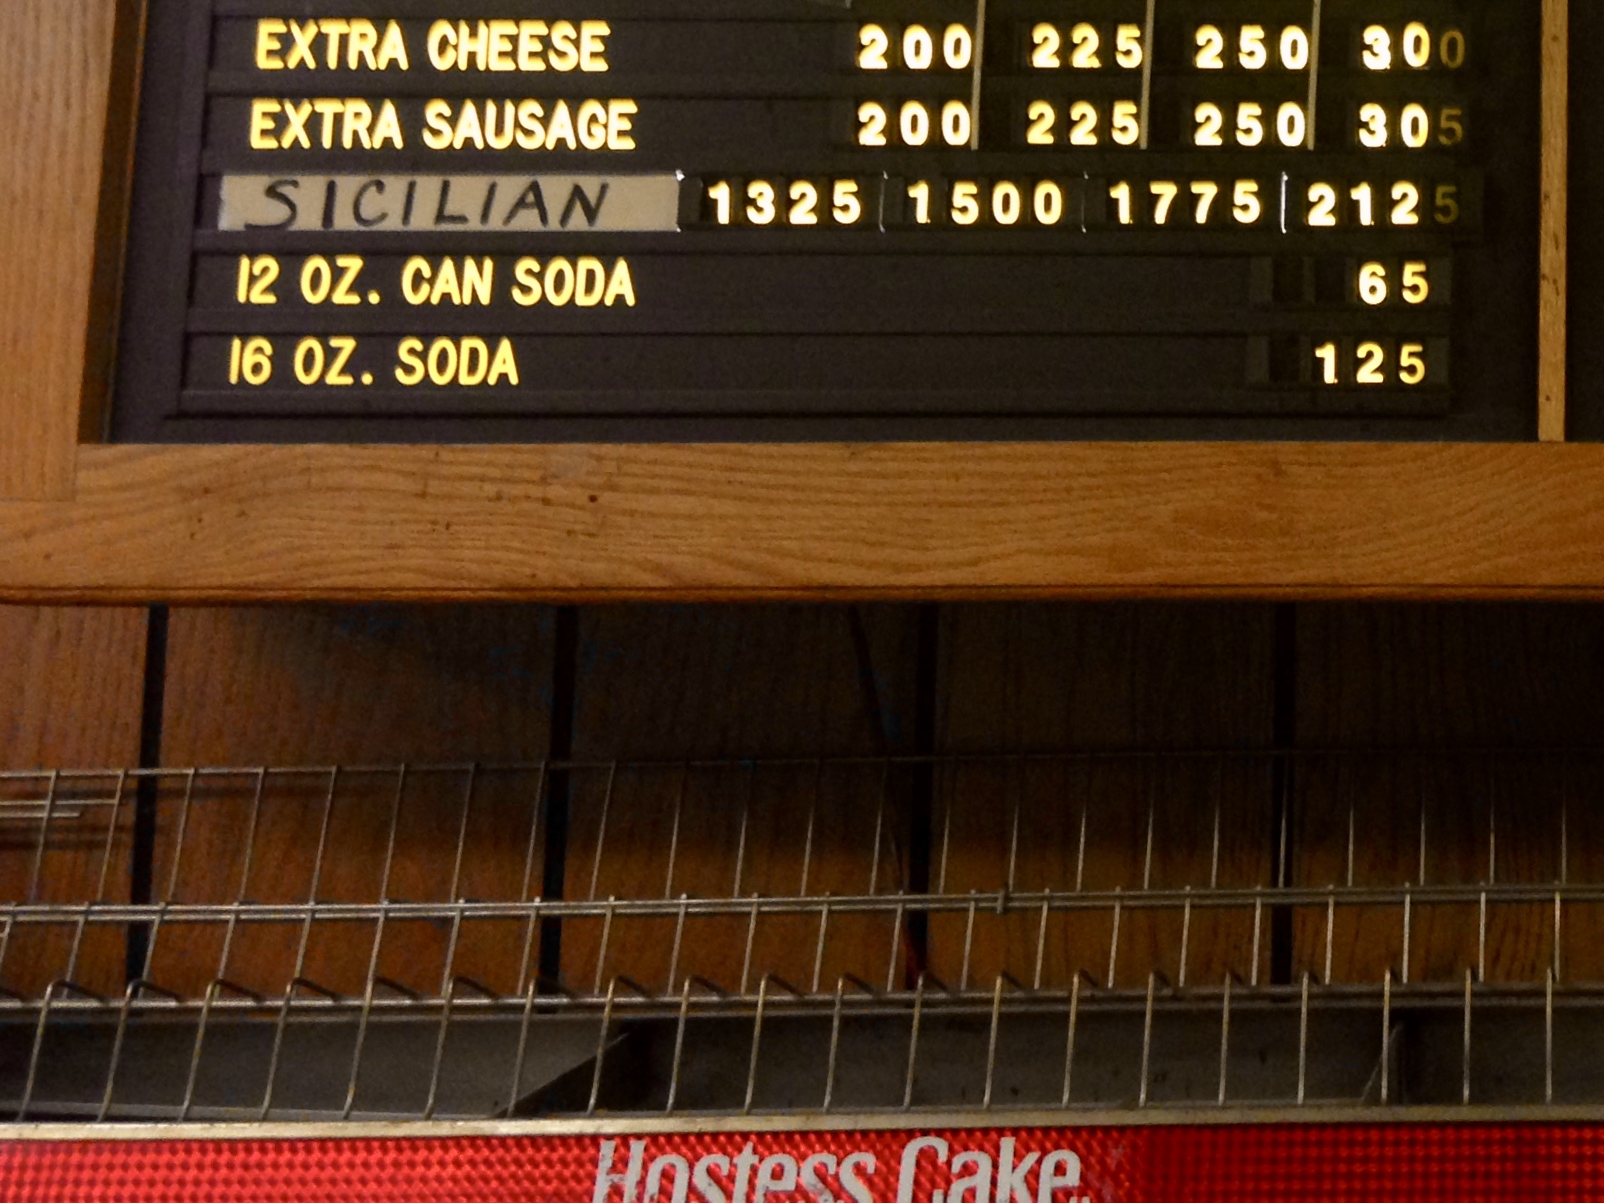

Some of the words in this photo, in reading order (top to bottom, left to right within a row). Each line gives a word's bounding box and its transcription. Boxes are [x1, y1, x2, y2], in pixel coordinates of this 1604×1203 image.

[255, 19, 409, 71] EXTRA
[427, 20, 611, 72] CHEESE
[858, 24, 972, 69] 200
[1031, 22, 1144, 69] 225
[1195, 25, 1309, 69] 250
[249, 98, 403, 149] EXTRA
[422, 99, 638, 150] SAUSAGE
[857, 101, 971, 147] 200
[1027, 101, 1139, 147] 225
[1194, 101, 1306, 147] 250
[245, 178, 610, 230] SICILIAN
[707, 179, 861, 225] 1325
[907, 180, 1062, 225] 1500
[1110, 181, 1261, 225] 1775
[237, 255, 281, 304] 12
[300, 256, 382, 305] OZ.
[401, 257, 494, 305] CAN
[511, 257, 637, 306] SODA
[1358, 261, 1429, 305] 65
[229, 337, 274, 384] 16
[294, 337, 375, 386] OZ.
[395, 337, 519, 386] SODA
[1315, 342, 1426, 384] 125
[590, 1136, 876, 1203] Hostess
[896, 1135, 1082, 1203] Cake
